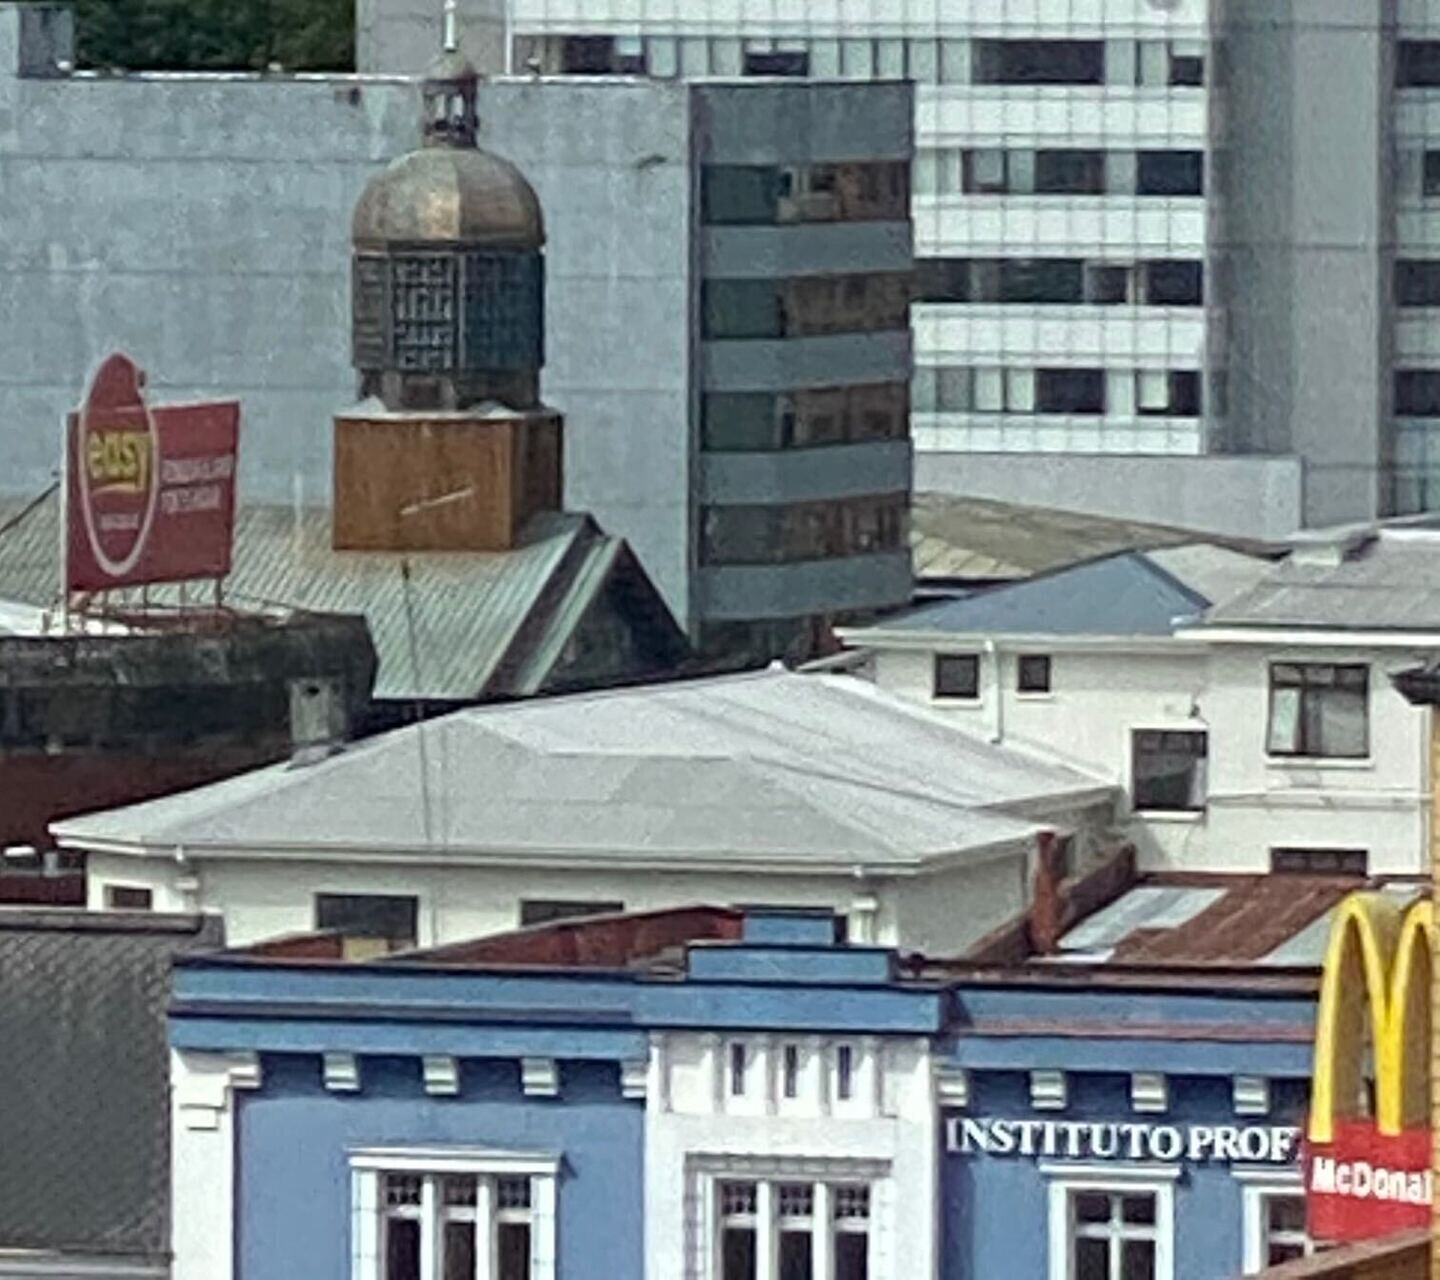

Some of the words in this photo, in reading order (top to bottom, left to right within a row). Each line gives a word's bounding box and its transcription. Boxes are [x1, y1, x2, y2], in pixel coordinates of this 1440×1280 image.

[946, 1118, 1183, 1159] INSTITUTO
[1187, 1126, 1303, 1161] PROF
[1311, 1156, 1432, 1206] McDonal
